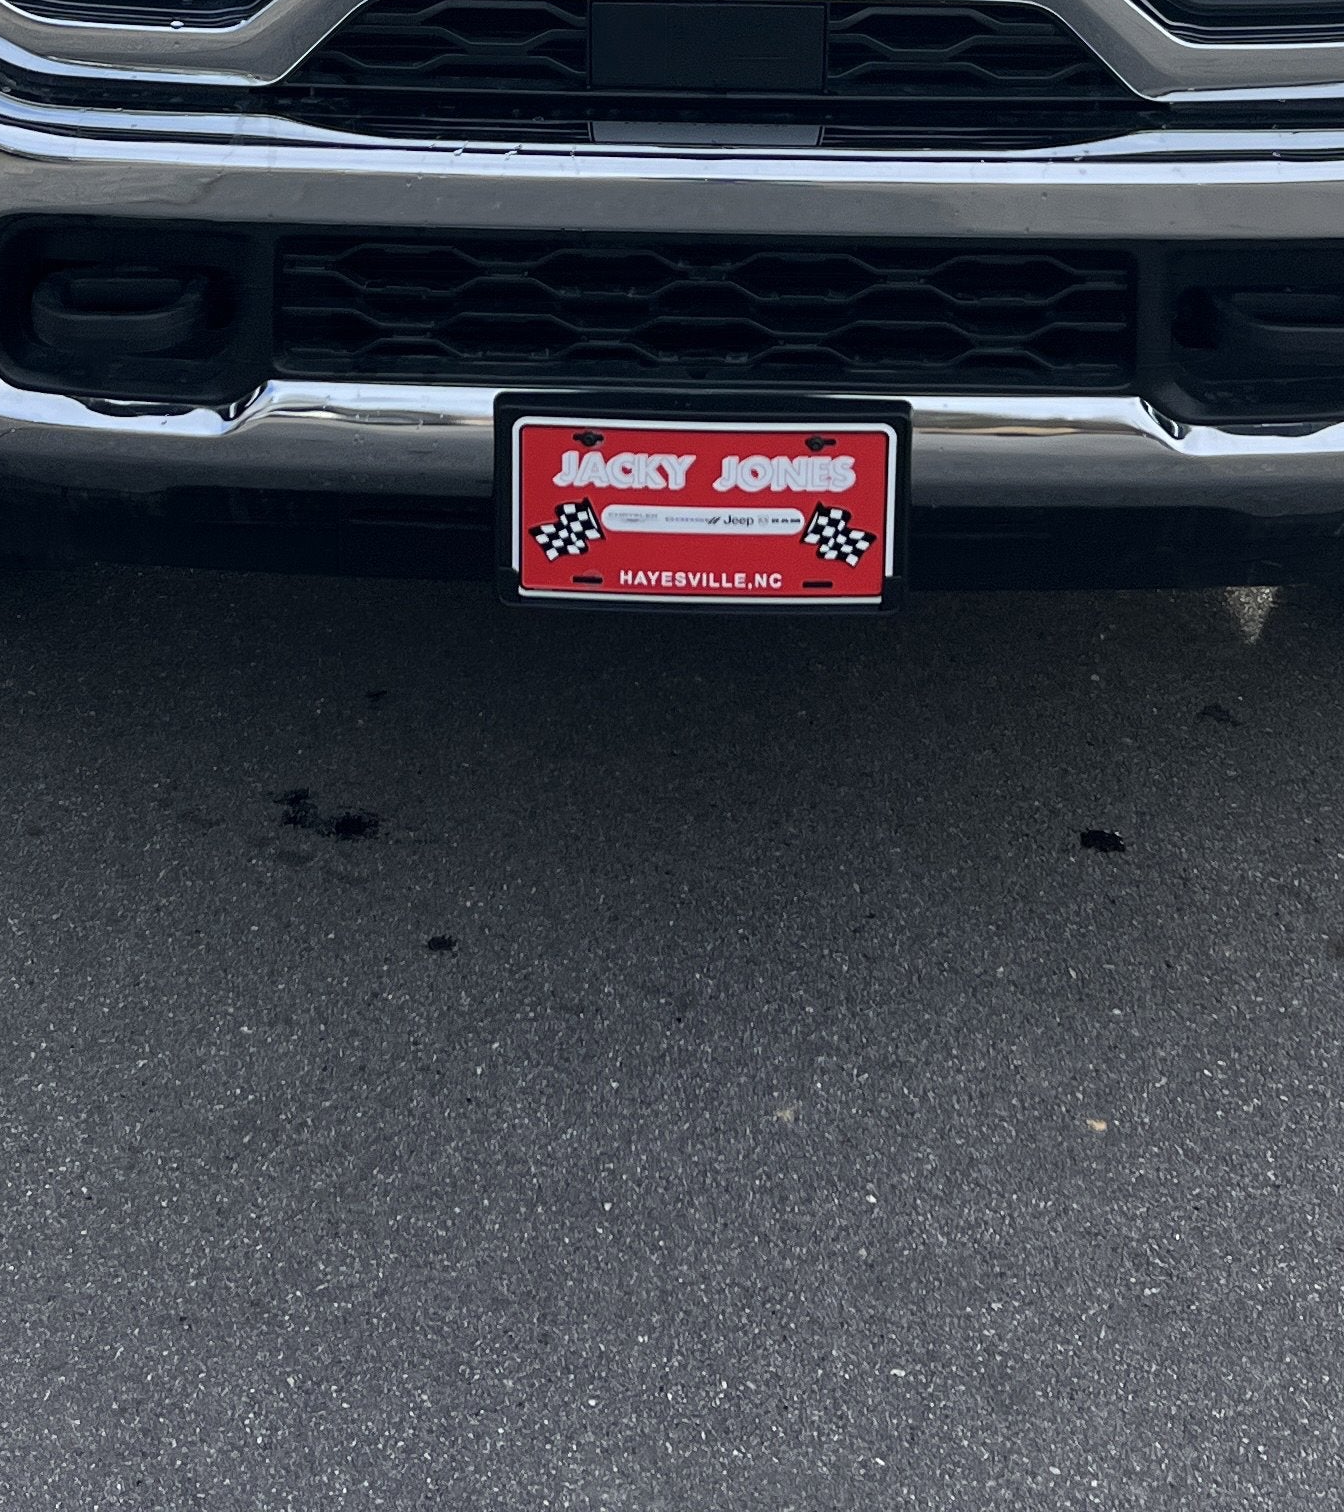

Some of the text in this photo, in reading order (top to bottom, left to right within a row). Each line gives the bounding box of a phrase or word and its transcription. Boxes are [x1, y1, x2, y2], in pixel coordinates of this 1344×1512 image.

[552, 449, 856, 493] JACKY JONES
[723, 514, 755, 527] Jeep
